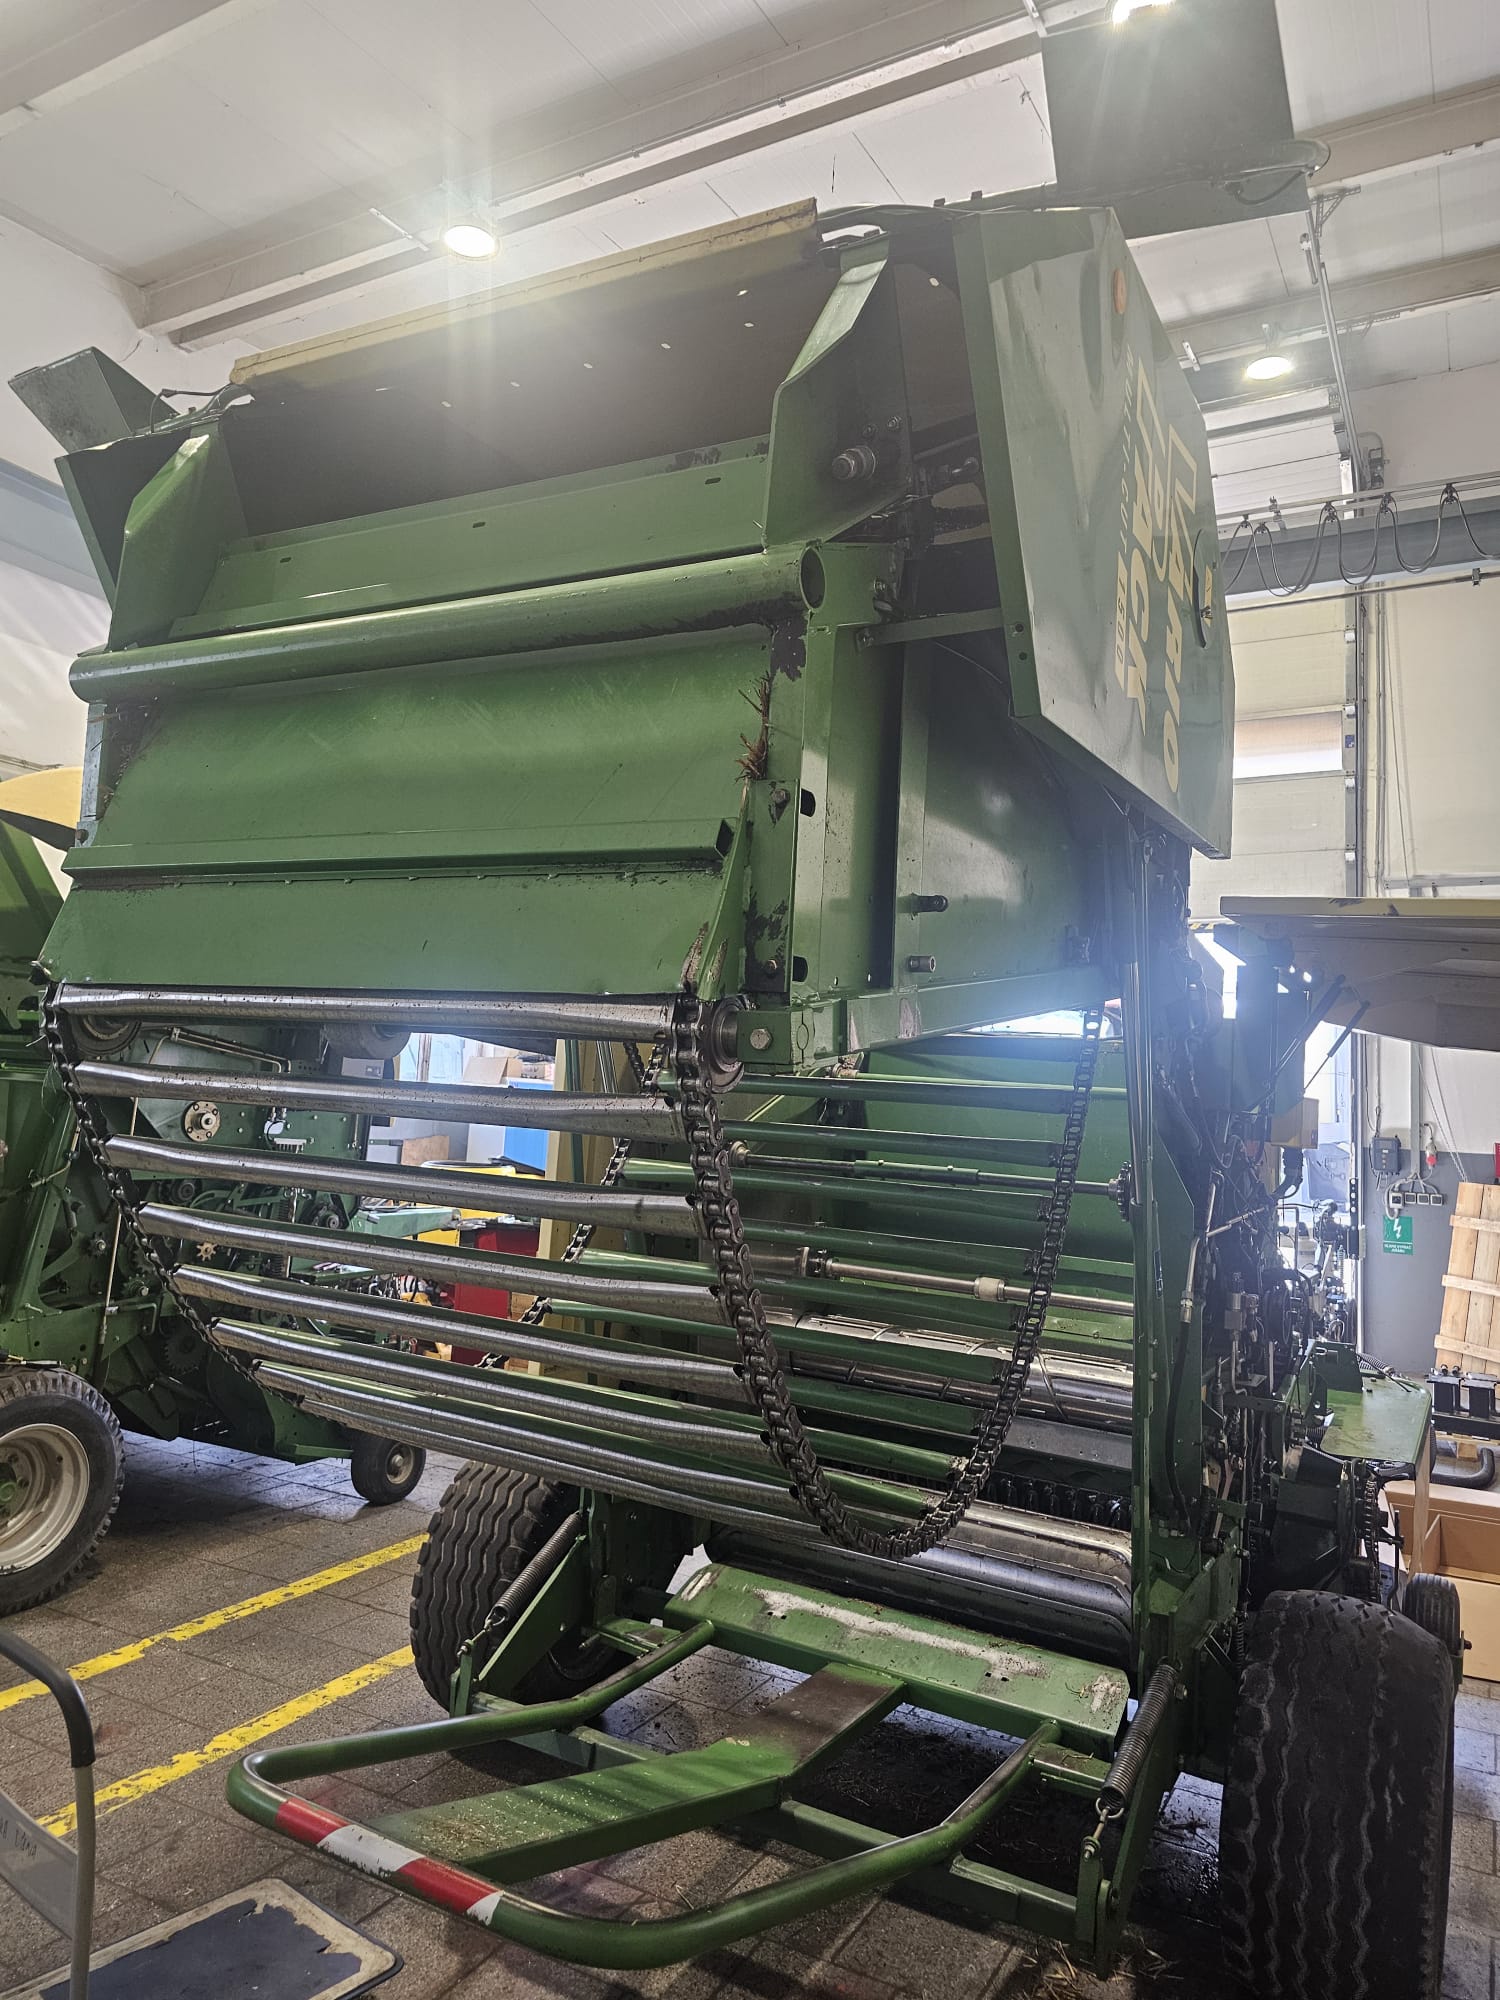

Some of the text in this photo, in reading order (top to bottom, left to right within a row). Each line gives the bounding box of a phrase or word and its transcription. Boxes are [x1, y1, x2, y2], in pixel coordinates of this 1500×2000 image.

[1115, 343, 1134, 665] MULTI-CUT 1500
[1127, 356, 1171, 737] PACK
[1163, 423, 1197, 793] VARIO
